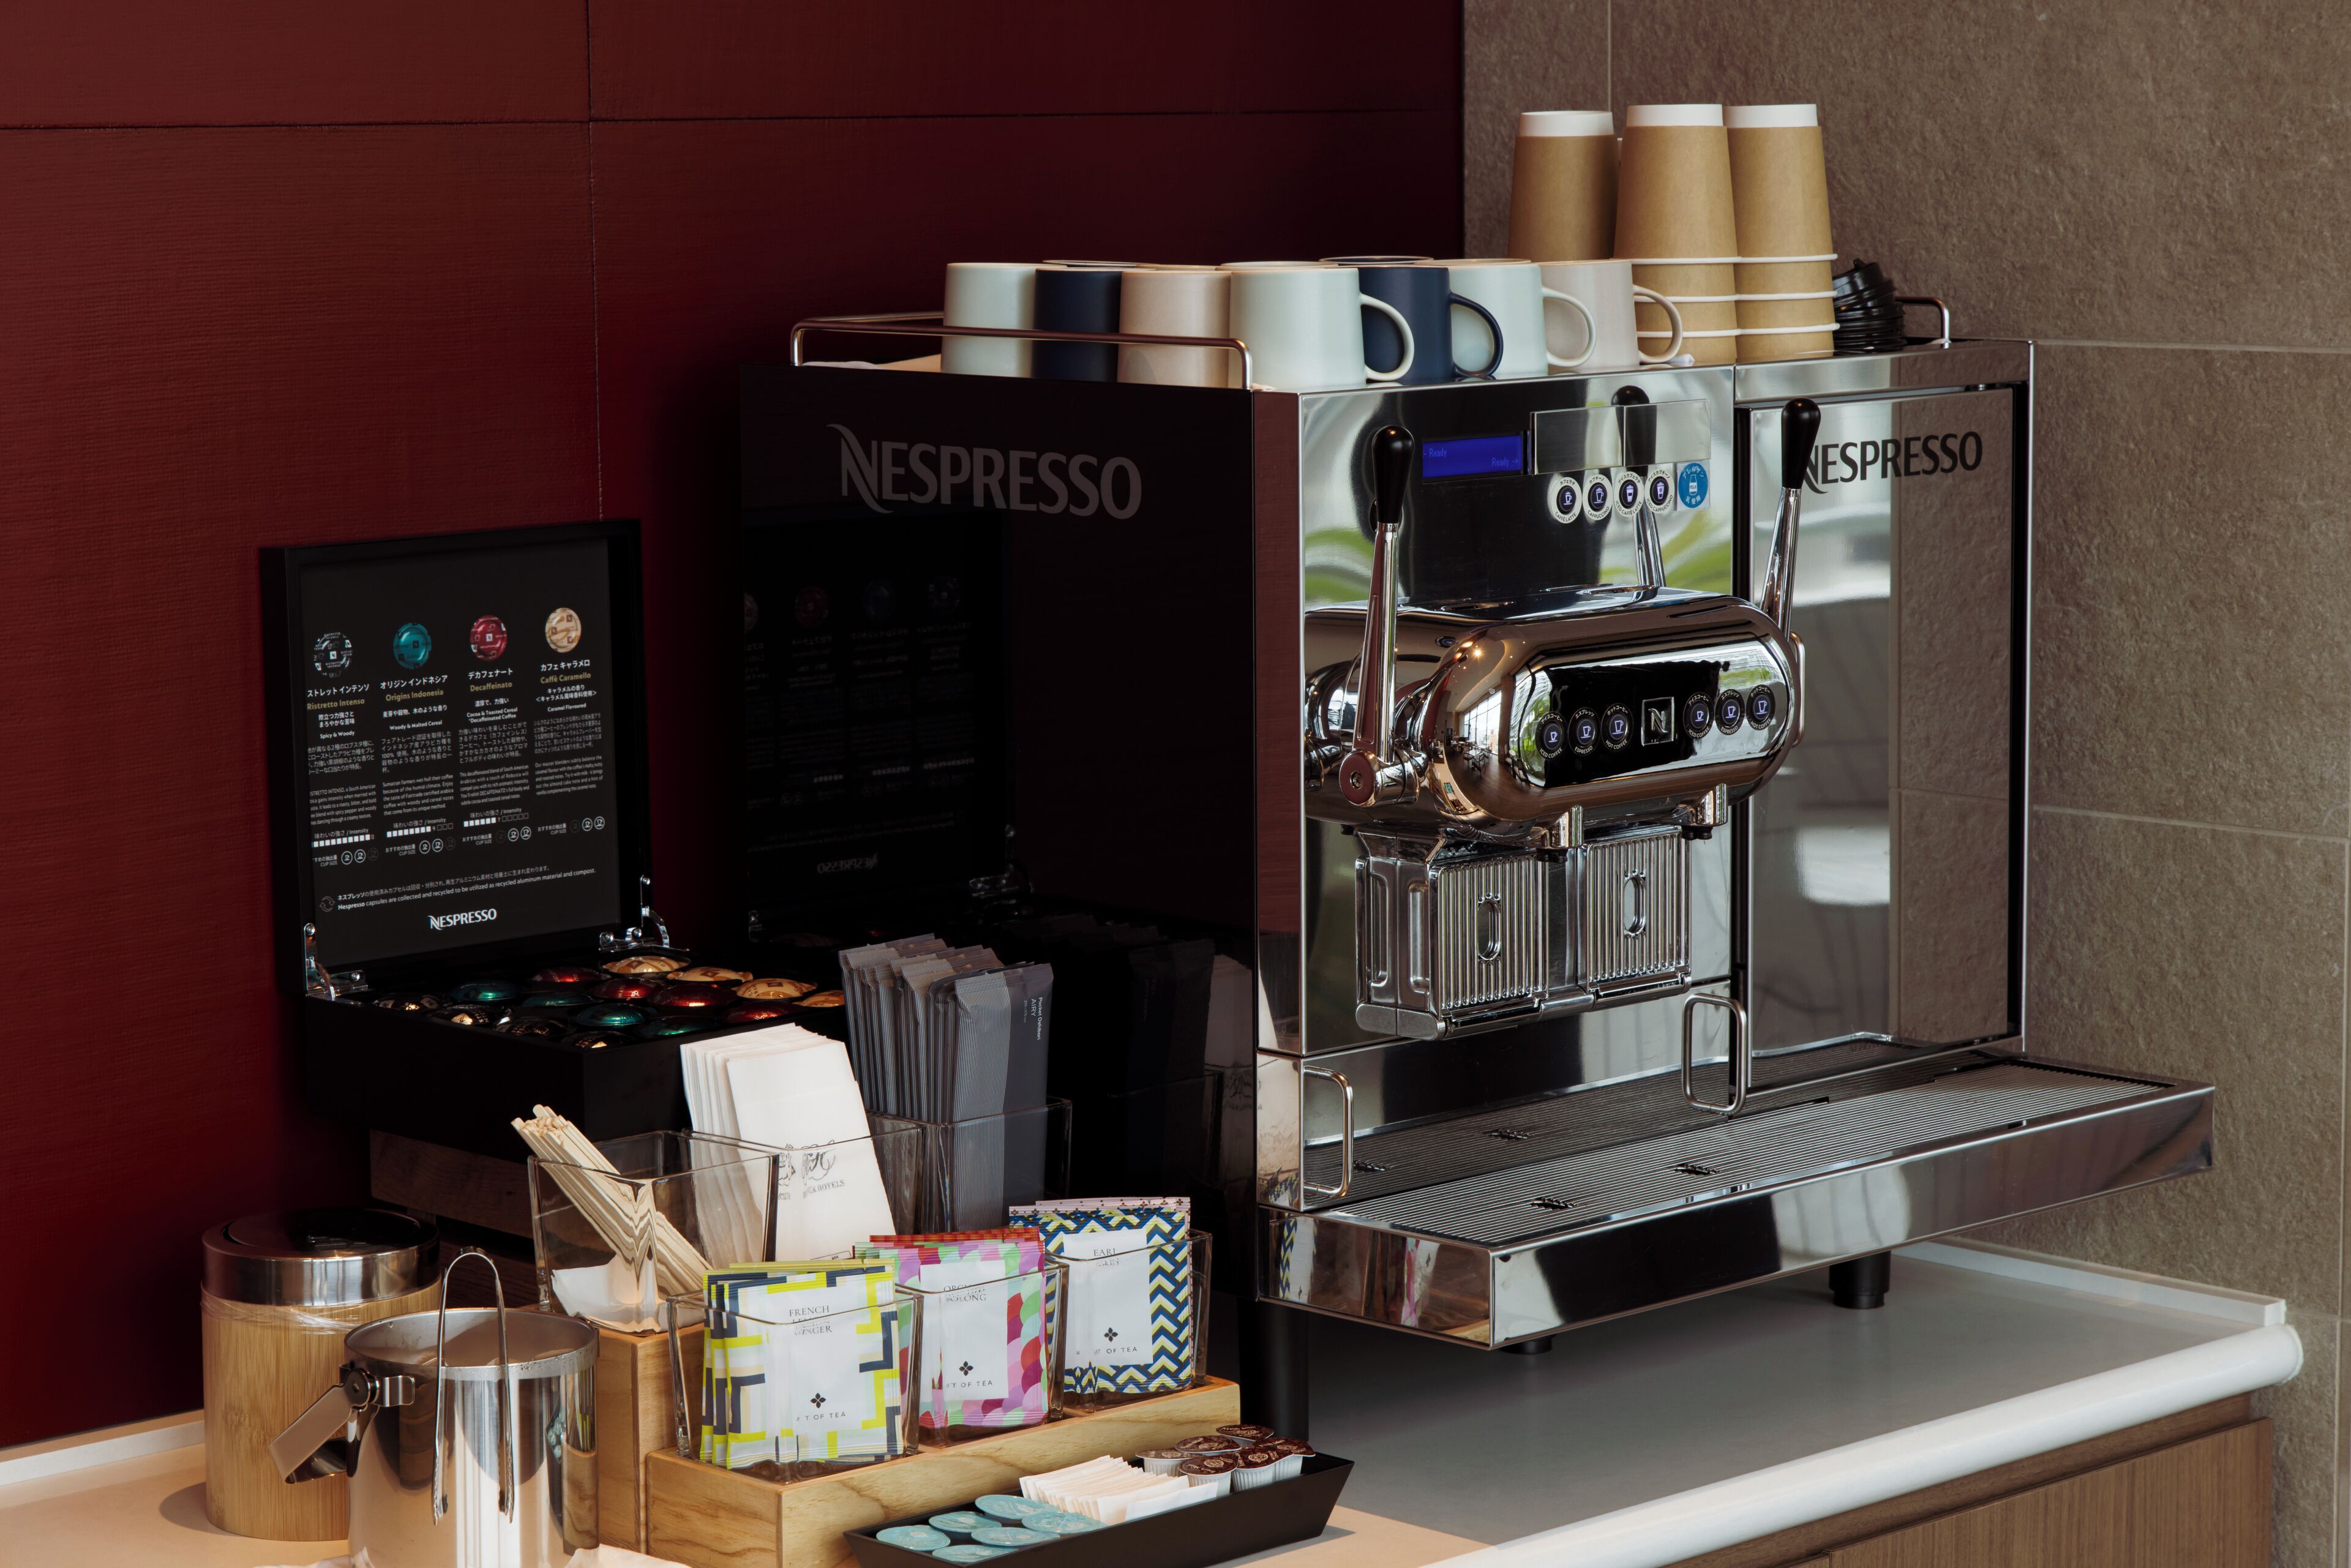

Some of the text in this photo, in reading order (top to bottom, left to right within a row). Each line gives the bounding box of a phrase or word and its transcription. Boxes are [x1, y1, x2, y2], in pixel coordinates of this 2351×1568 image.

[1429, 448, 1447, 457] Ready
[1491, 457, 1509, 467] Ready
[826, 424, 1141, 519] NESPRESSO
[1648, 470, 1670, 482] アイスカプチーノ
[1683, 466, 1704, 479] アレルゲン
[1618, 473, 1641, 484] アイスカフェラテ
[1633, 501, 1641, 513] LATTE
[1653, 495, 1673, 512] CAPPUCCINO
[1565, 512, 1577, 522] LATTE
[1588, 506, 1610, 519] CAPPUCCINO
[541, 658, 590, 671] カフェ キャラメロ
[468, 667, 512, 680] デカフェナート
[541, 671, 591, 683] Caffè Caramello
[380, 674, 448, 689] オリジン インドネシア
[470, 680, 512, 692] Decaffeinato
[307, 683, 369, 697] ストレット インテンソ
[547, 684, 584, 694] キャラメルの香り
[1750, 686, 1771, 697] ホットコーヒー
[386, 688, 443, 703] Origins Indonesia
[1689, 694, 1709, 705] アイスコーヒー
[1721, 690, 1740, 700] エスプレッソ
[307, 697, 364, 710] Ristretto Intenso
[1575, 709, 1595, 719] エスプレッソ
[1607, 705, 1629, 716] ホットコーヒー
[1540, 713, 1562, 724] アイスコーヒー
[1758, 718, 1771, 729] COFFEE
[1697, 727, 1710, 738] COFFEE
[1613, 738, 1628, 749] COFFEE
[1548, 748, 1562, 759] COFFEE
[1574, 745, 1593, 754] ESPRESSO
[338, 901, 365, 911] Nespresso
[366, 898, 387, 907] capsules
[397, 893, 421, 901] collected
[432, 888, 454, 898] recycled
[495, 879, 516, 888] recycled
[573, 868, 596, 877] compost.
[428, 908, 497, 931] NESPRESSO
[817, 1180, 845, 1191] HOTELS
[789, 1305, 830, 1316] FRENCH
